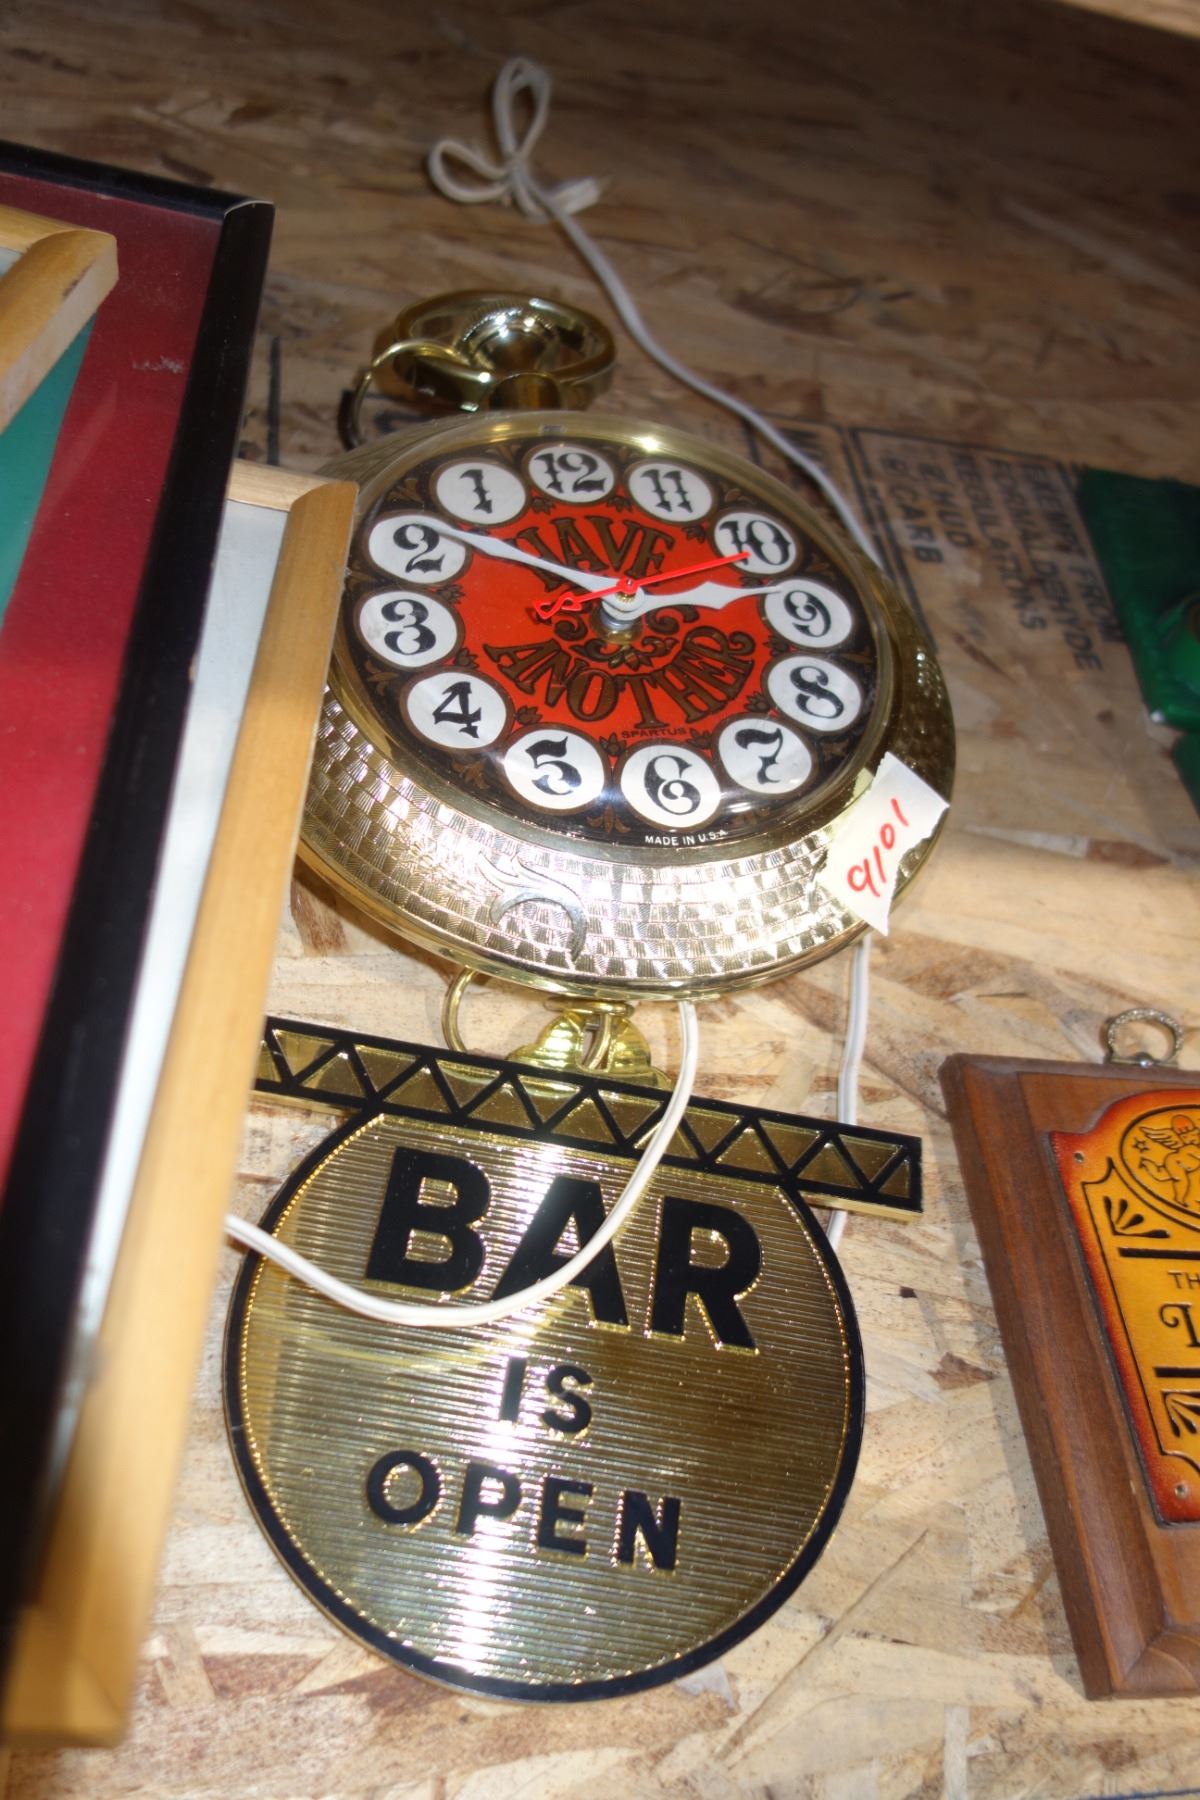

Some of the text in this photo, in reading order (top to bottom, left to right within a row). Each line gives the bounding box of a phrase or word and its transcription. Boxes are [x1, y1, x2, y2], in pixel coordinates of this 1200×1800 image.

[461, 468, 492, 513] 1
[535, 451, 607, 495] 12
[641, 468, 695, 513] 11
[393, 523, 444, 572] 2
[720, 520, 793, 567] 10
[892, 487, 944, 561] CARB
[504, 515, 675, 592] HAVE
[381, 600, 437, 655] 3
[783, 589, 832, 638] 9
[483, 625, 756, 729] ANOTHER
[789, 666, 844, 720] 8
[432, 681, 482, 739] 4
[621, 727, 688, 738] SPARTUS
[525, 736, 582, 796] 5
[644, 754, 702, 816] 6
[735, 728, 785, 786] 7
[644, 834, 679, 846] MADE
[683, 834, 695, 844] IN
[364, 1145, 762, 1353] BAR
[499, 1357, 593, 1434] IS
[366, 1450, 682, 1571] OPEN
